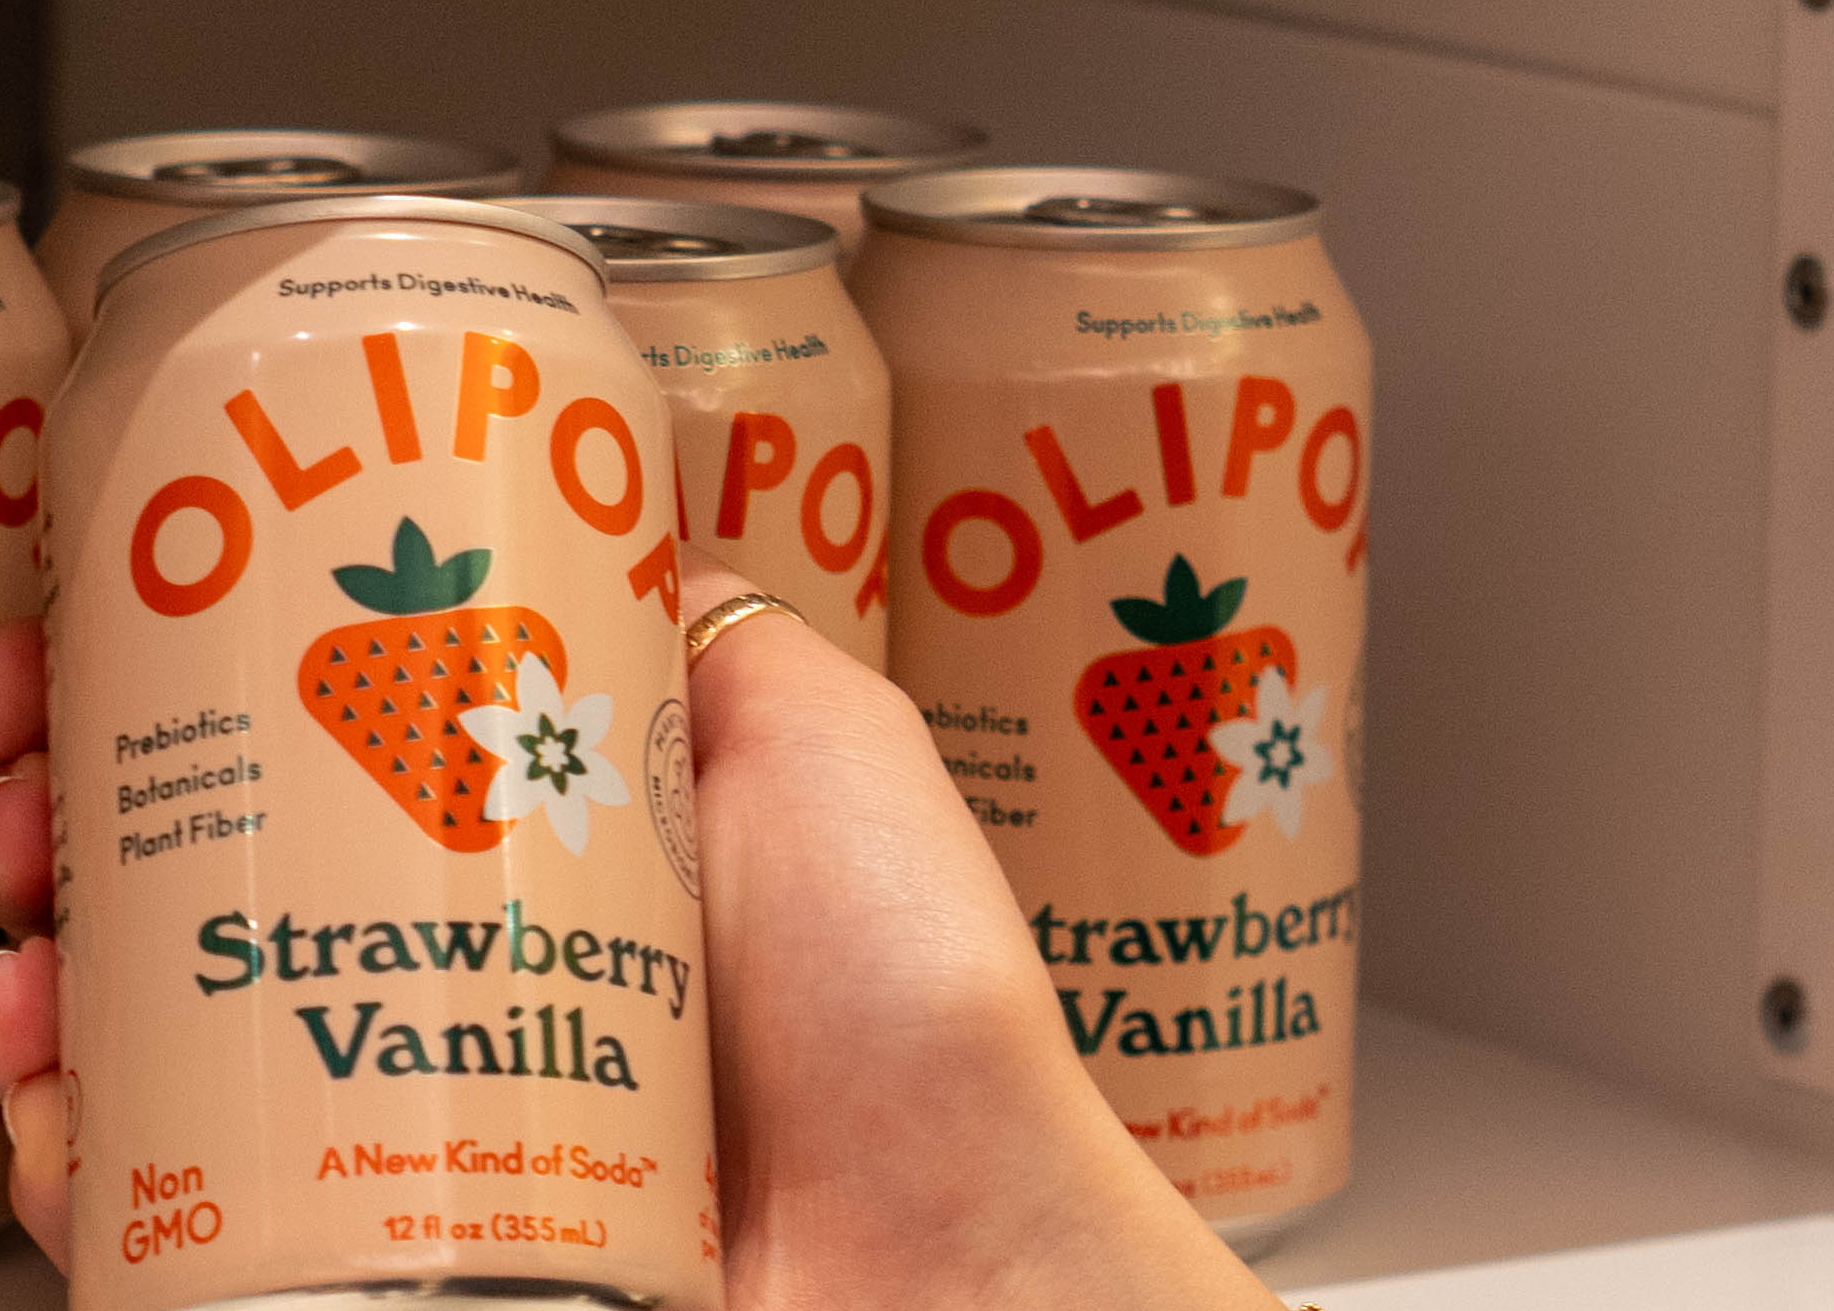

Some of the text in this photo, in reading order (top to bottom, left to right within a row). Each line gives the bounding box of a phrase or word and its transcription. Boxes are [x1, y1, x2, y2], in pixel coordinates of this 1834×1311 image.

[278, 272, 392, 299] Supports
[397, 272, 511, 297] Digestive
[1076, 309, 1178, 339] Supports
[921, 374, 1369, 618] OLIPO
[116, 709, 251, 764] Prebiotics
[922, 702, 1028, 735] ebiotics
[118, 754, 262, 814] Botanicals
[119, 810, 268, 867] Plant Fiber
[194, 898, 691, 1021] Strawberry
[1056, 975, 1321, 1057] Vanilla
[294, 1001, 640, 1091] Vanilla
[130, 1162, 204, 1209] Non
[317, 1146, 348, 1181] A
[352, 1142, 441, 1177] New
[444, 1138, 525, 1175] Kind
[530, 1143, 564, 1177] of
[122, 1200, 224, 1265] GMO
[383, 1213, 415, 1242] 12
[451, 1220, 483, 1242] oz
